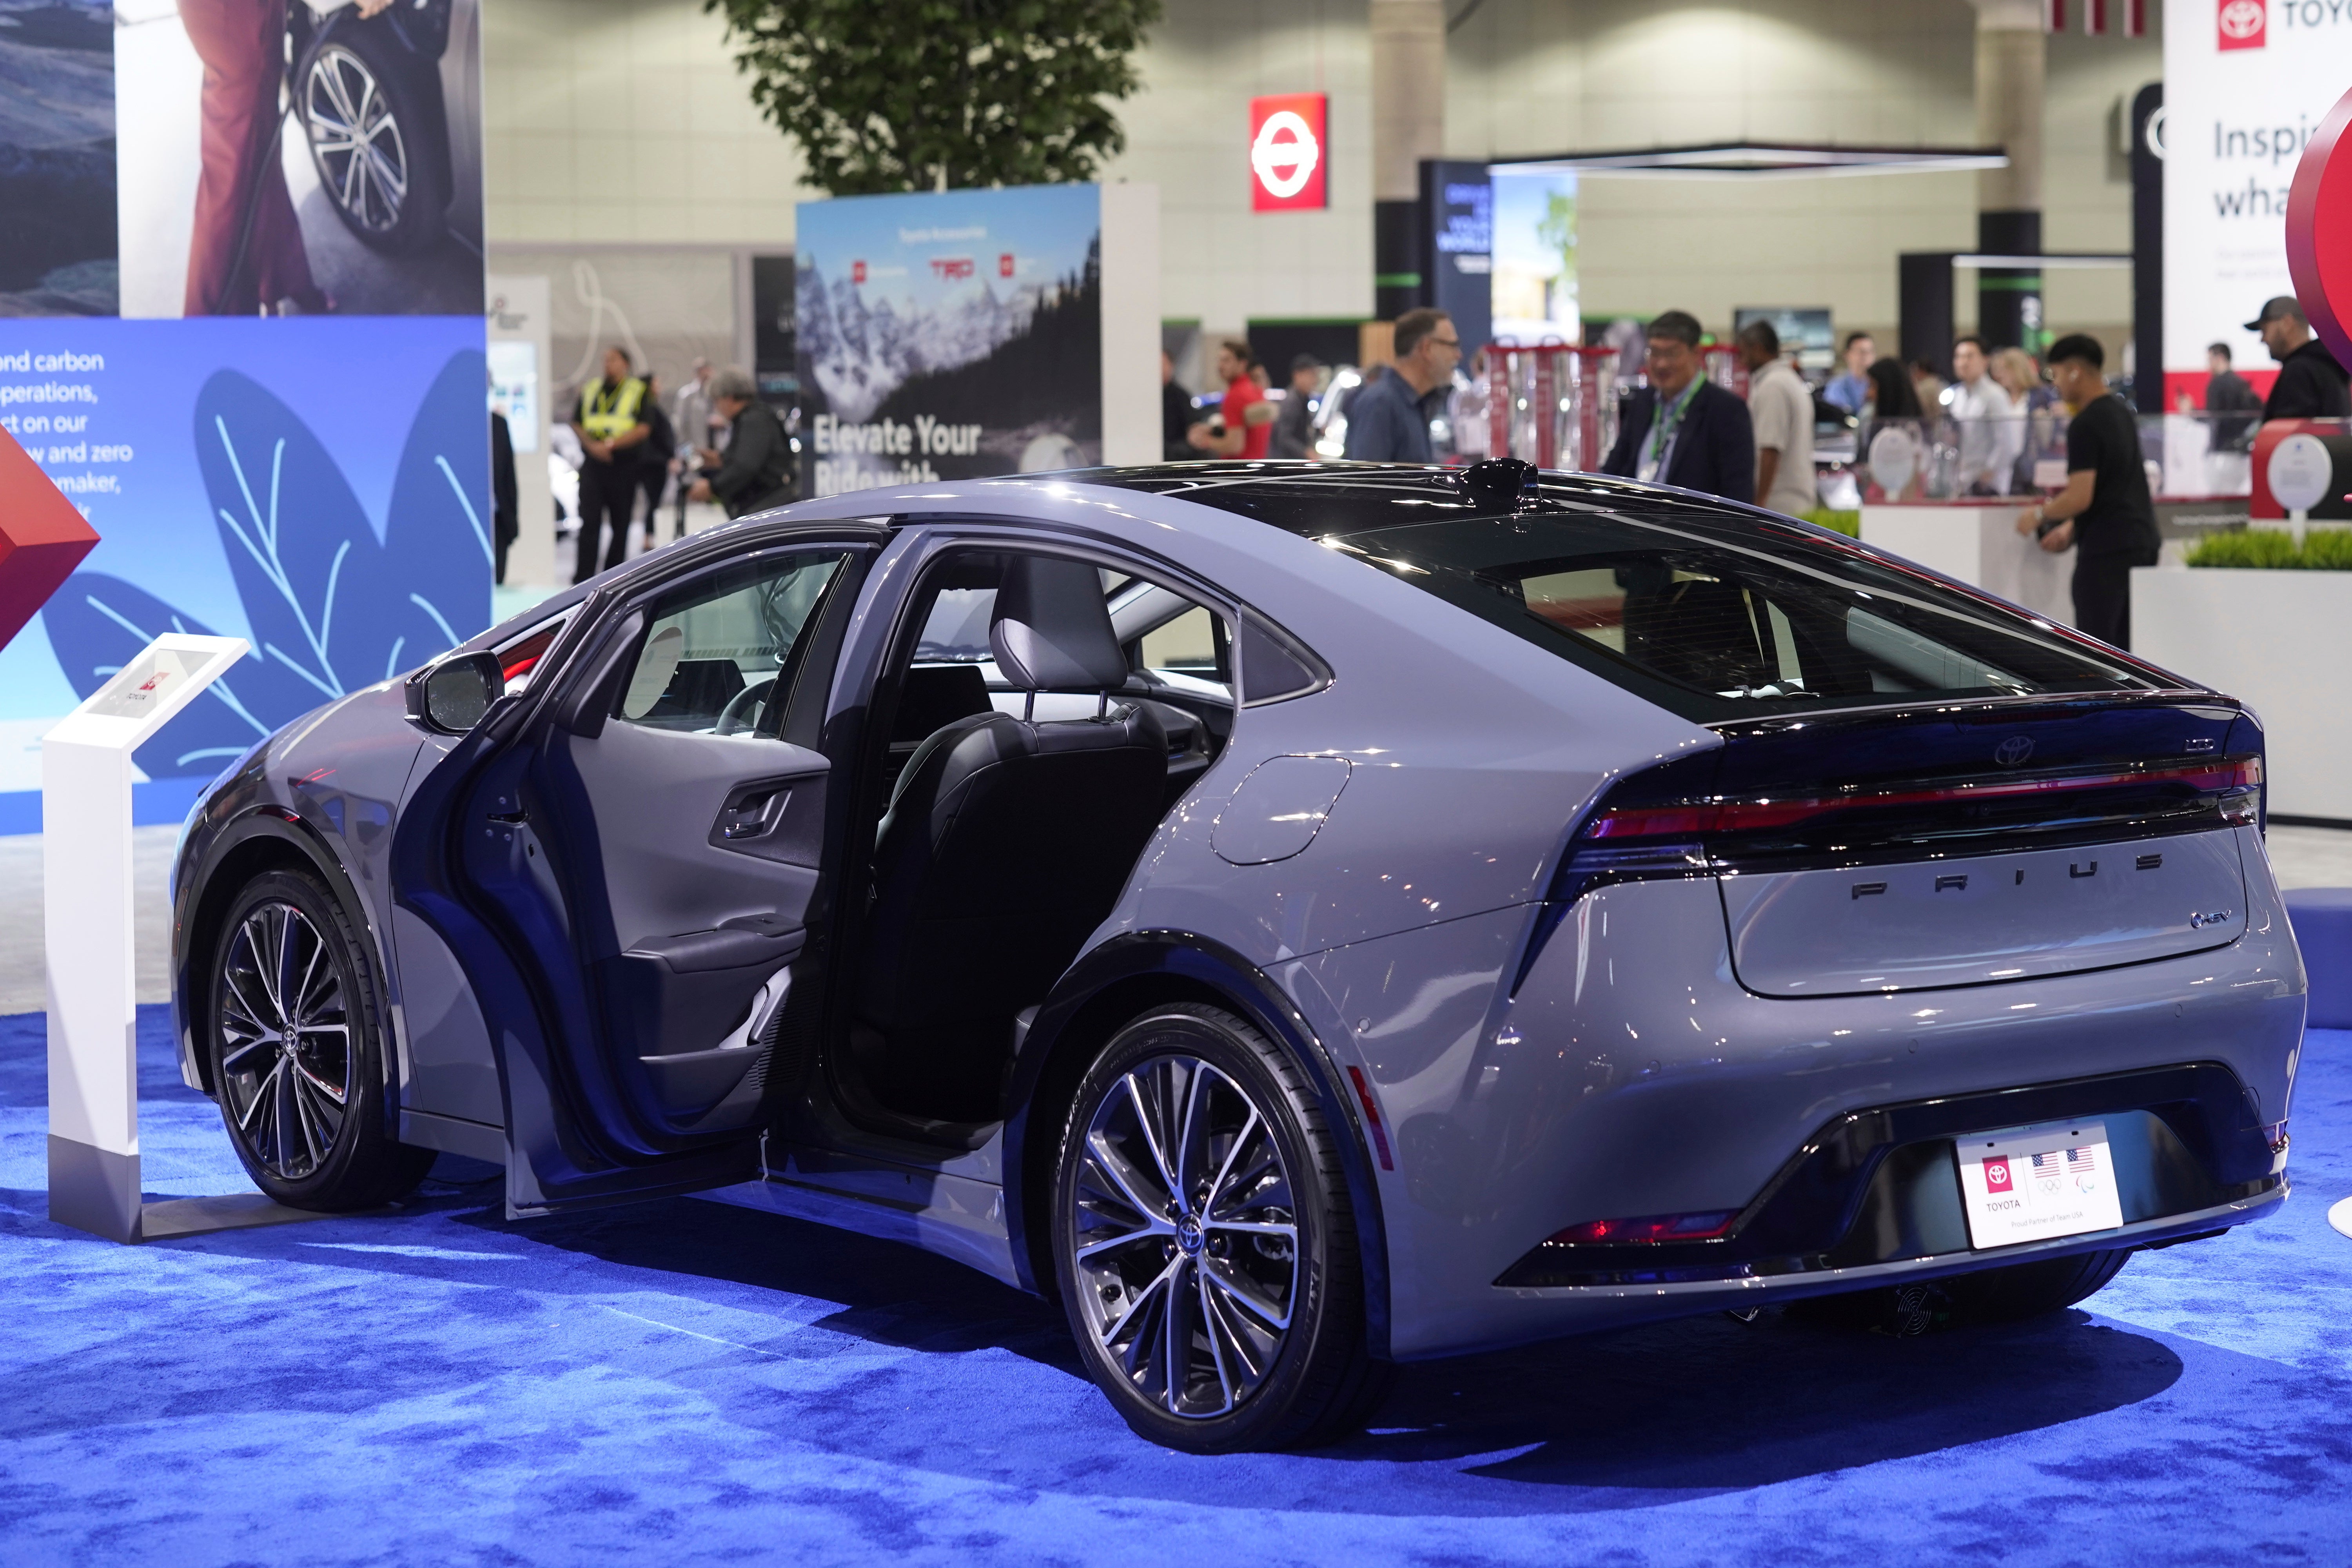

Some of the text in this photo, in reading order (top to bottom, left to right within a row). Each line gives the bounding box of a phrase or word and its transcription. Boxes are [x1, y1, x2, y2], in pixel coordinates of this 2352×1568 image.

[2281, 0, 2352, 27] TOY
[2214, 114, 2318, 166] Inspi
[0, 349, 104, 372] nd carbon
[23, 416, 50, 434] on
[53, 415, 89, 433] our
[813, 413, 983, 456] Elevate Your
[48, 441, 87, 463] and
[91, 445, 134, 463] zero
[814, 459, 875, 497] Ride
[1852, 853, 2162, 900] PRIUS
[1987, 1200, 2021, 1212] TOYOTA
